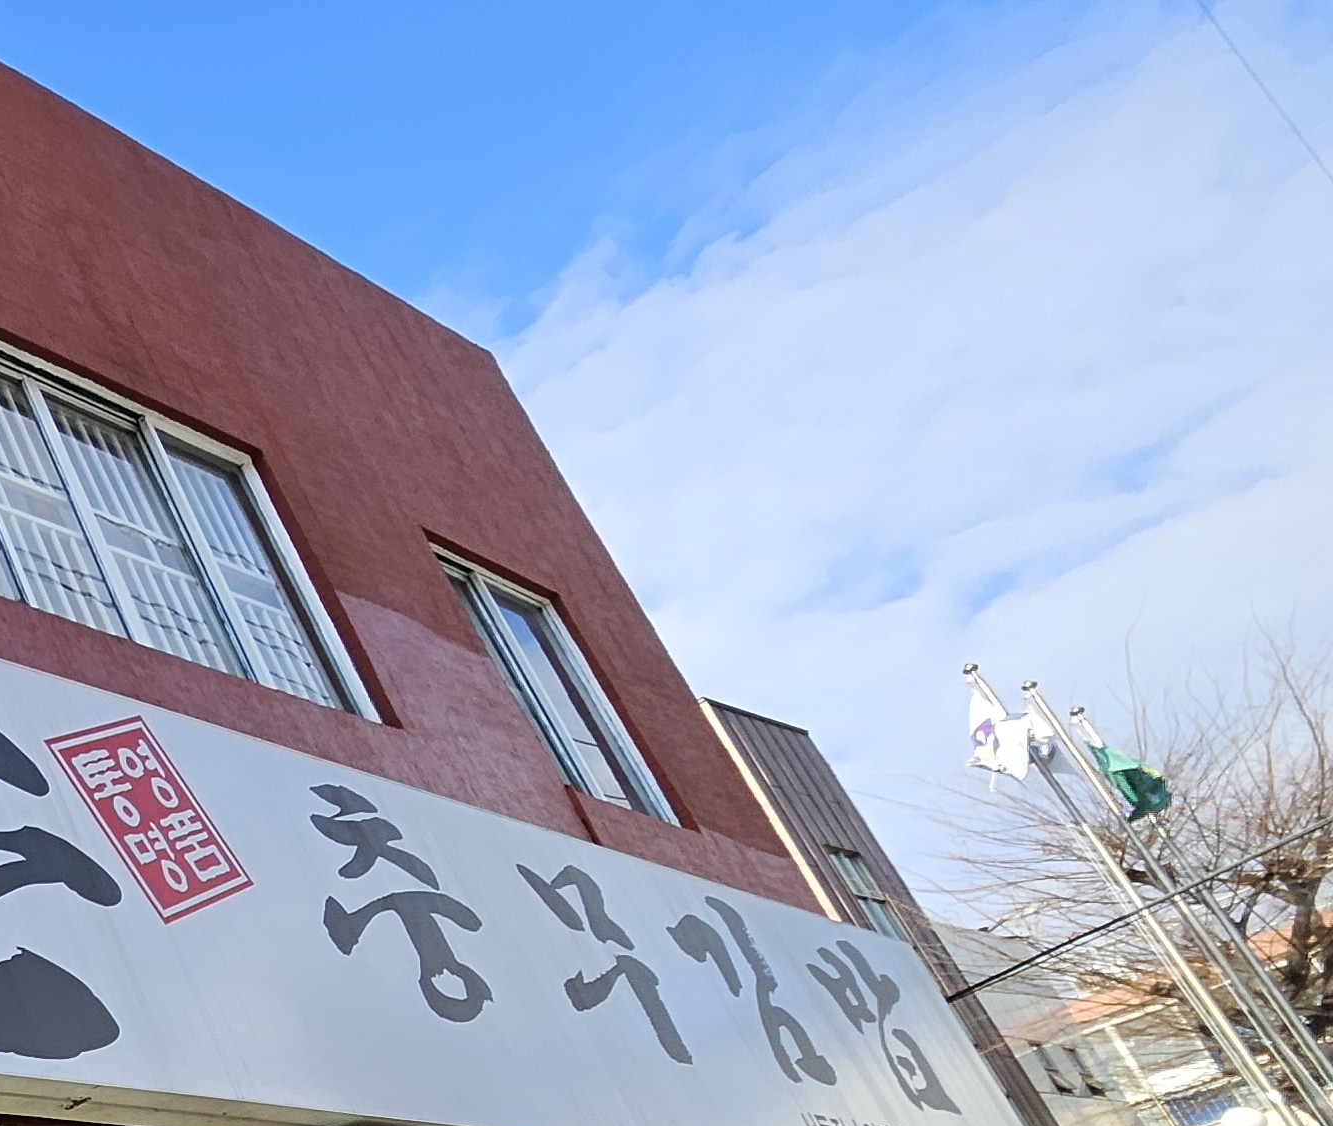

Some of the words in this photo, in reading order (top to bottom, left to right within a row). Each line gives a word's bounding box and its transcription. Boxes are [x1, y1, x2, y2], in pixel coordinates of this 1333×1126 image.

[72, 739, 179, 827] 통영
[124, 809, 231, 893] 명품
[309, 784, 961, 1116] 충무김밥
